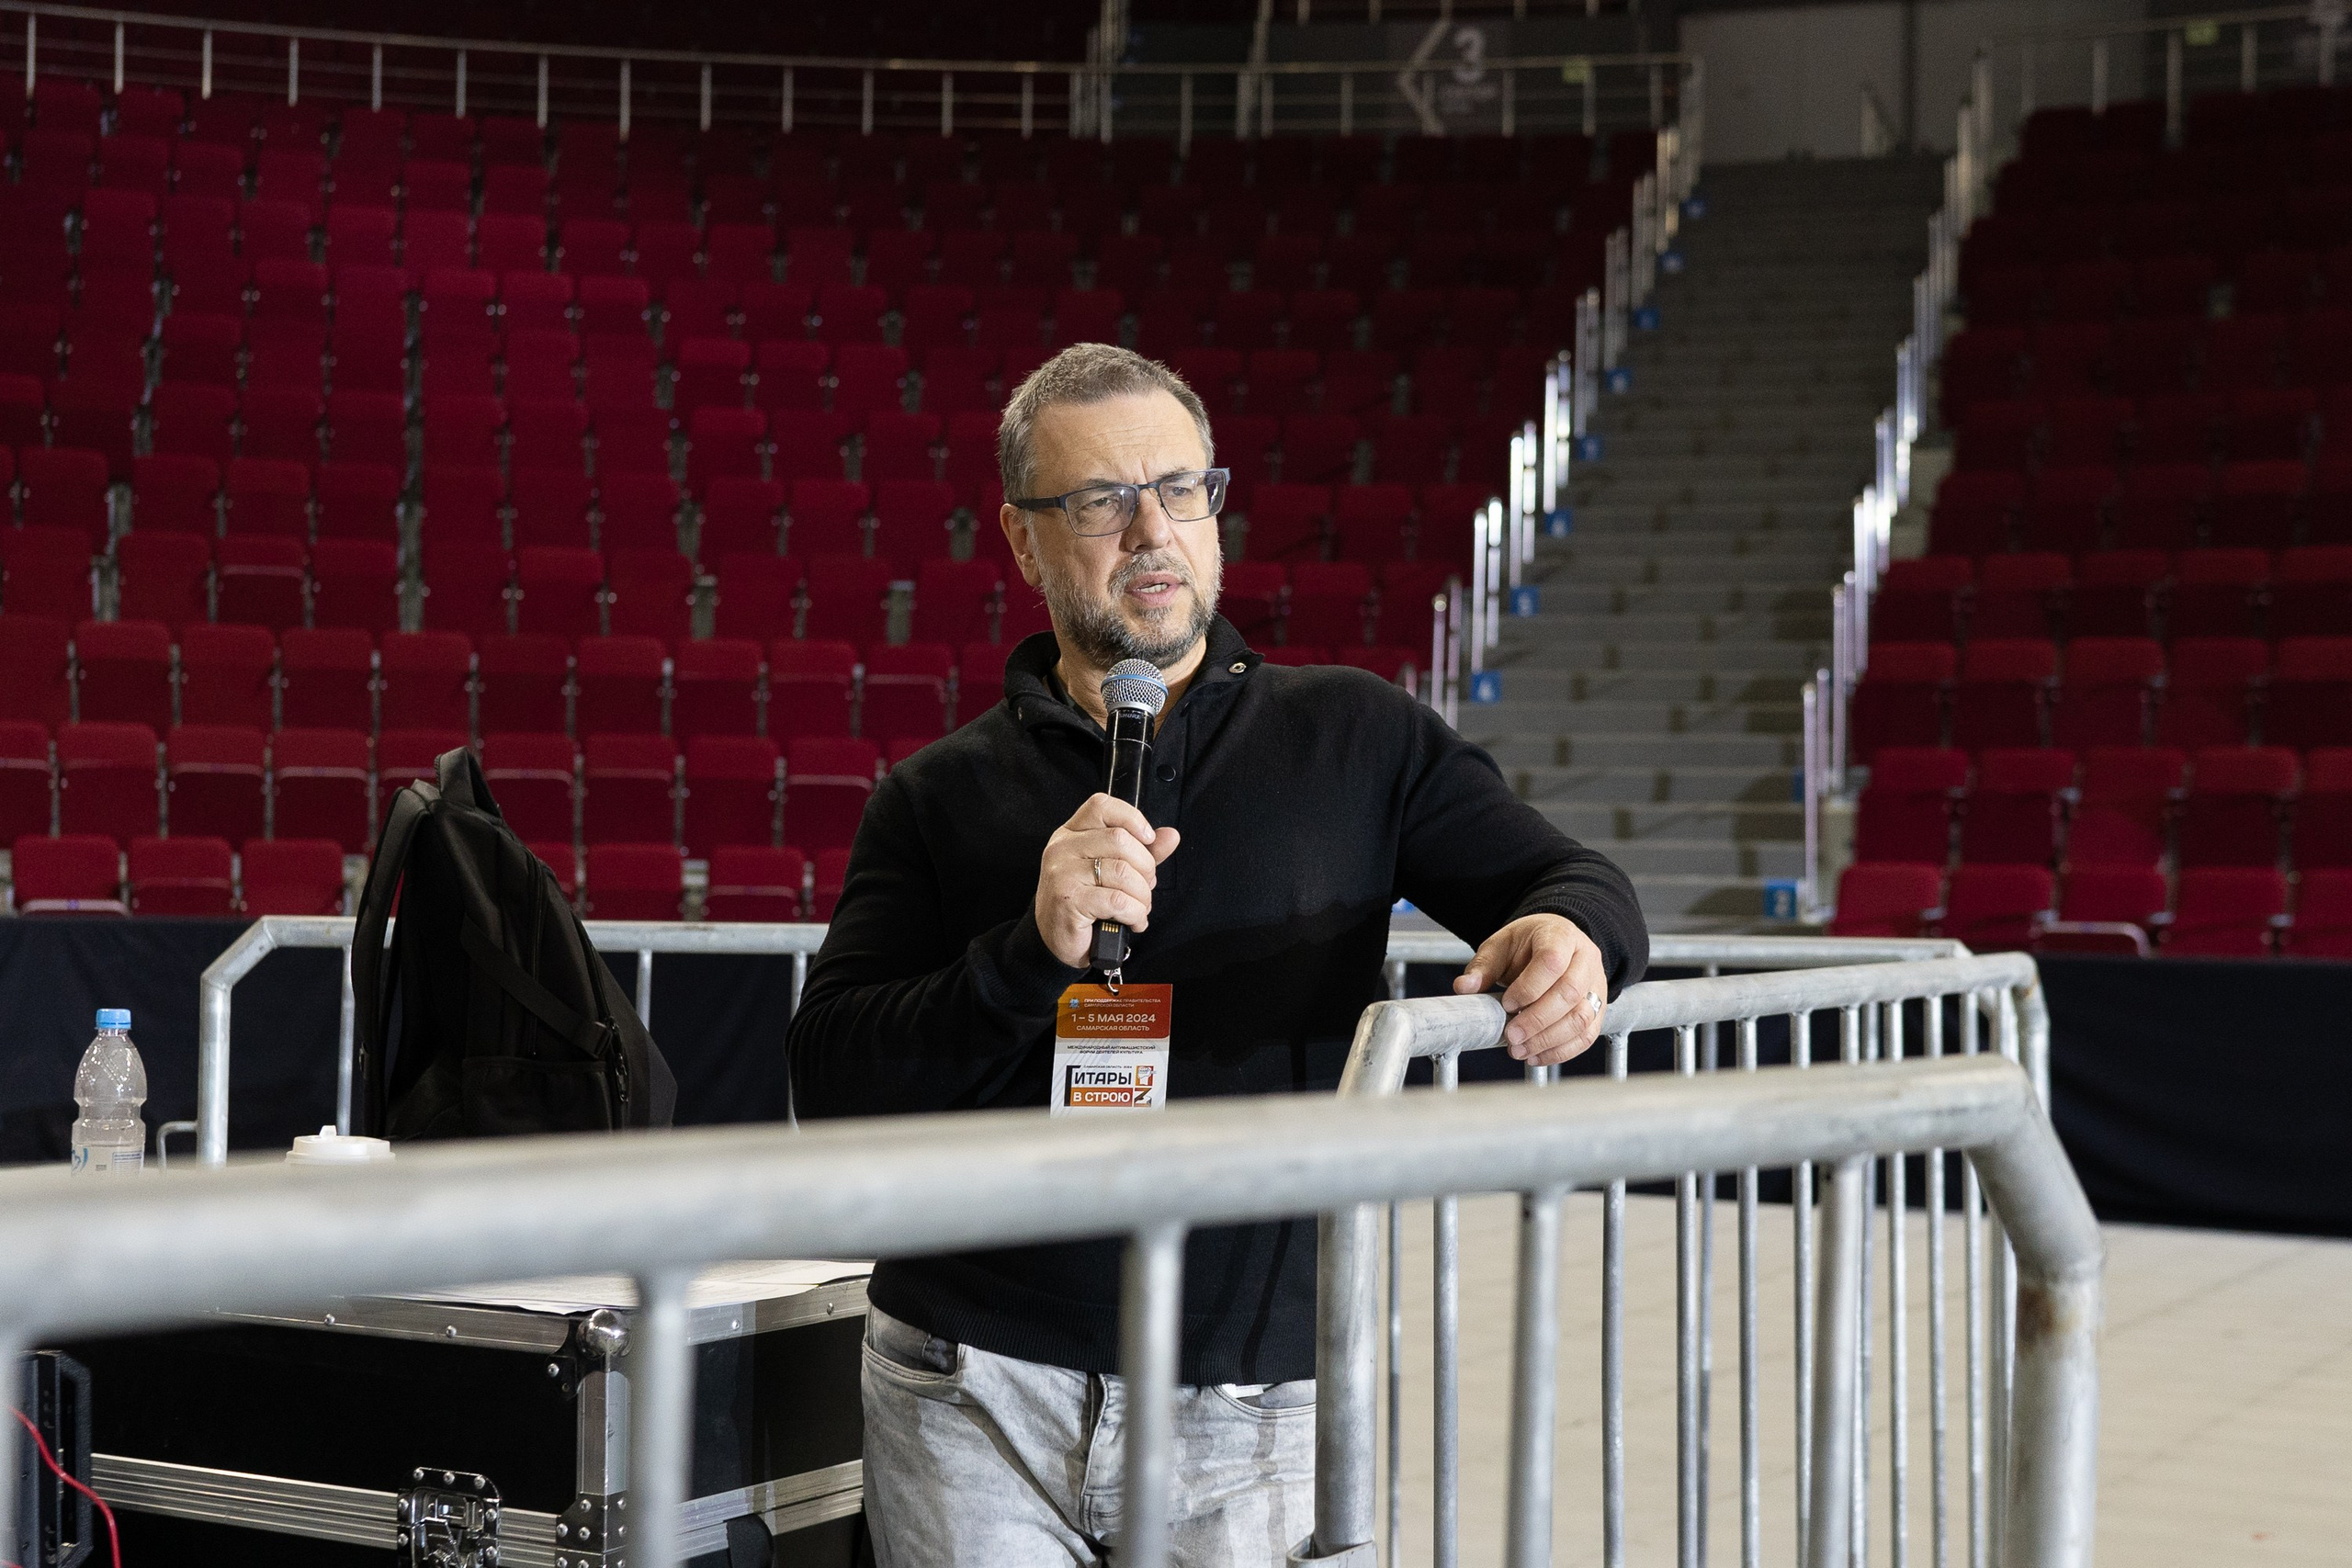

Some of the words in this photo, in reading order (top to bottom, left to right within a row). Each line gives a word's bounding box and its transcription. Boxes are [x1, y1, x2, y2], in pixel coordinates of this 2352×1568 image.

[1454, 27, 1486, 84] 3
[1071, 1014, 1077, 1022] 1
[1088, 1014, 1095, 1022] 5
[1097, 1014, 1124, 1022] МАЯ
[1125, 1014, 1156, 1022] 2024
[1073, 1091, 1082, 1102] В
[1085, 1091, 1131, 1102] СТРОЮ
